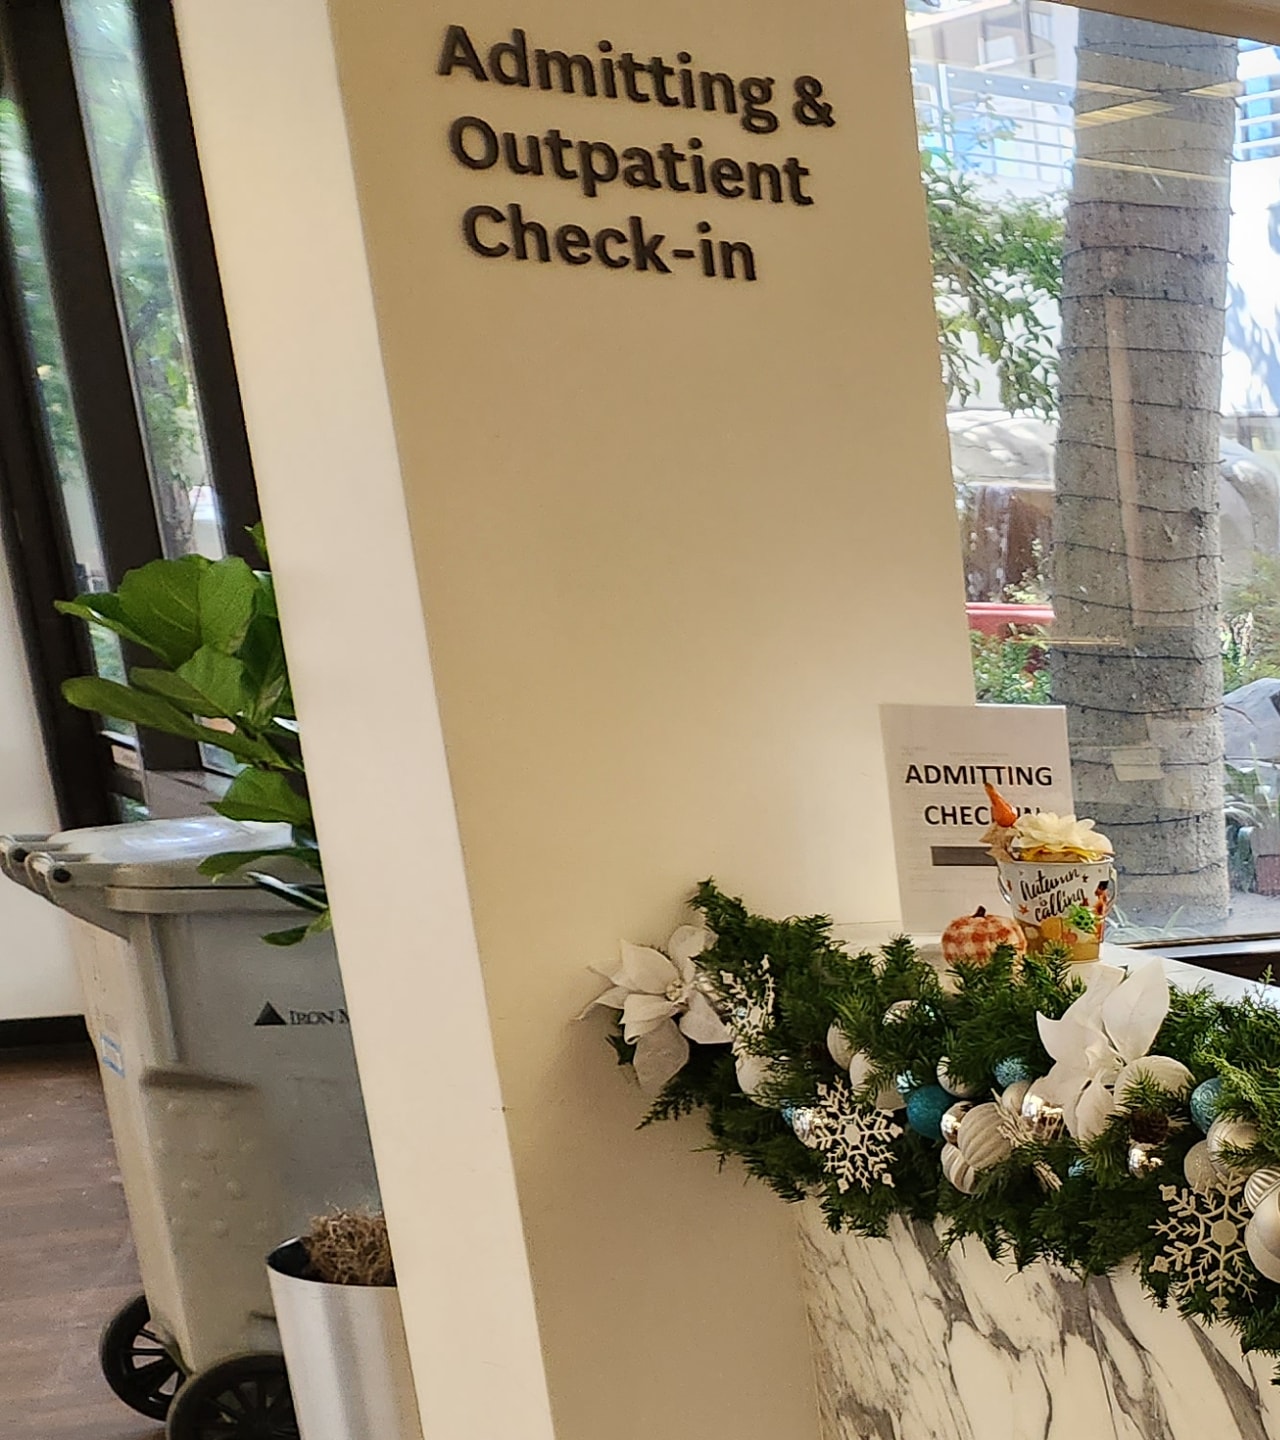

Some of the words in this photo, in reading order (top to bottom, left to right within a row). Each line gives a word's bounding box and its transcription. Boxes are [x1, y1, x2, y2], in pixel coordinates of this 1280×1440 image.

[438, 24, 779, 134] Admitting
[792, 75, 836, 128] &
[449, 115, 814, 205] Outpatient
[462, 203, 757, 281] Check-in
[905, 764, 1052, 786] ADMITTING
[924, 805, 995, 825] CHEC
[1020, 868, 1079, 901] Autumn
[289, 1010, 334, 1025] IRON
